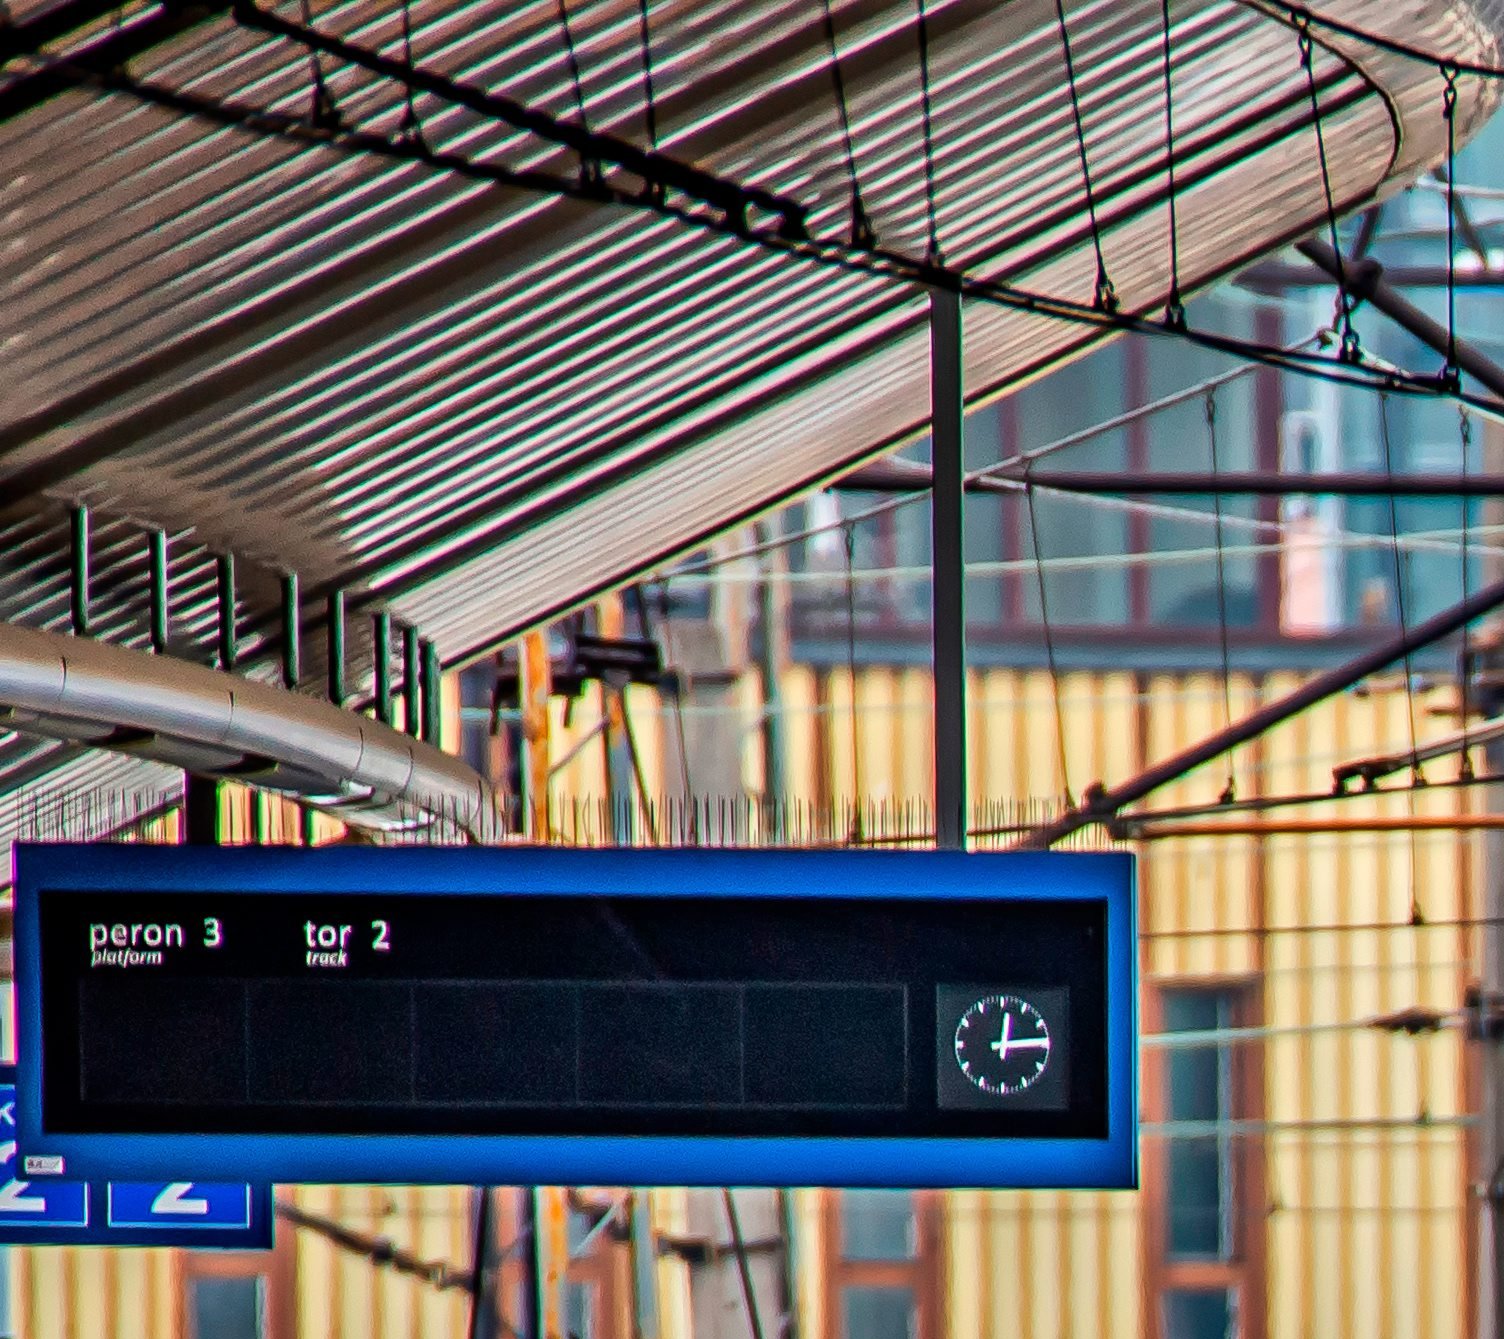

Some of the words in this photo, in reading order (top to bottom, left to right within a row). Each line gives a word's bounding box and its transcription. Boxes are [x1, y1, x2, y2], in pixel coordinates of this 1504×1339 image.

[90, 922, 184, 950] peron
[203, 917, 223, 948] 3
[305, 920, 351, 949] tor
[371, 919, 390, 950] 2
[91, 948, 162, 968] platform
[306, 949, 347, 967] track
